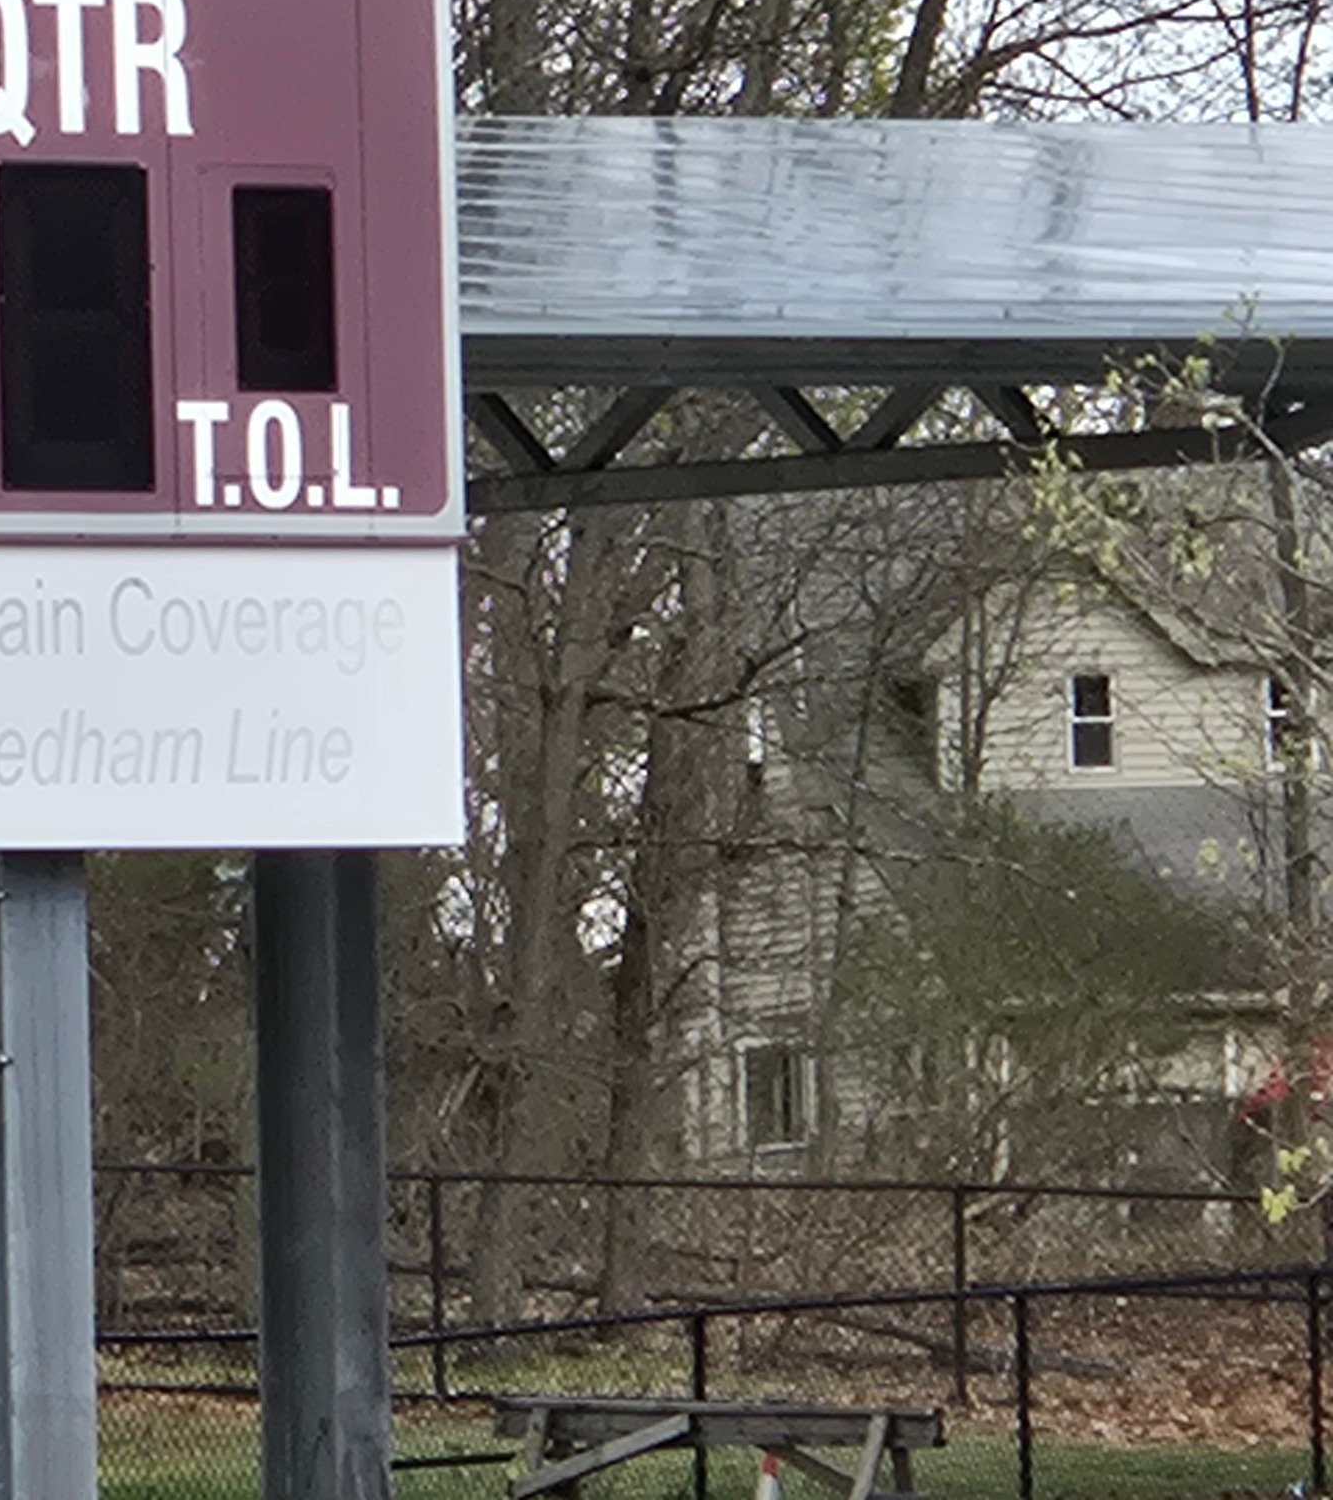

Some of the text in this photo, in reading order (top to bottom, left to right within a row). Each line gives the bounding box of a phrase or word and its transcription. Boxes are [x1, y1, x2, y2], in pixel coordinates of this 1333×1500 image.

[176, 398, 400, 509] T.O.L.
[109, 576, 405, 676] Coverage
[225, 706, 354, 785] Line
